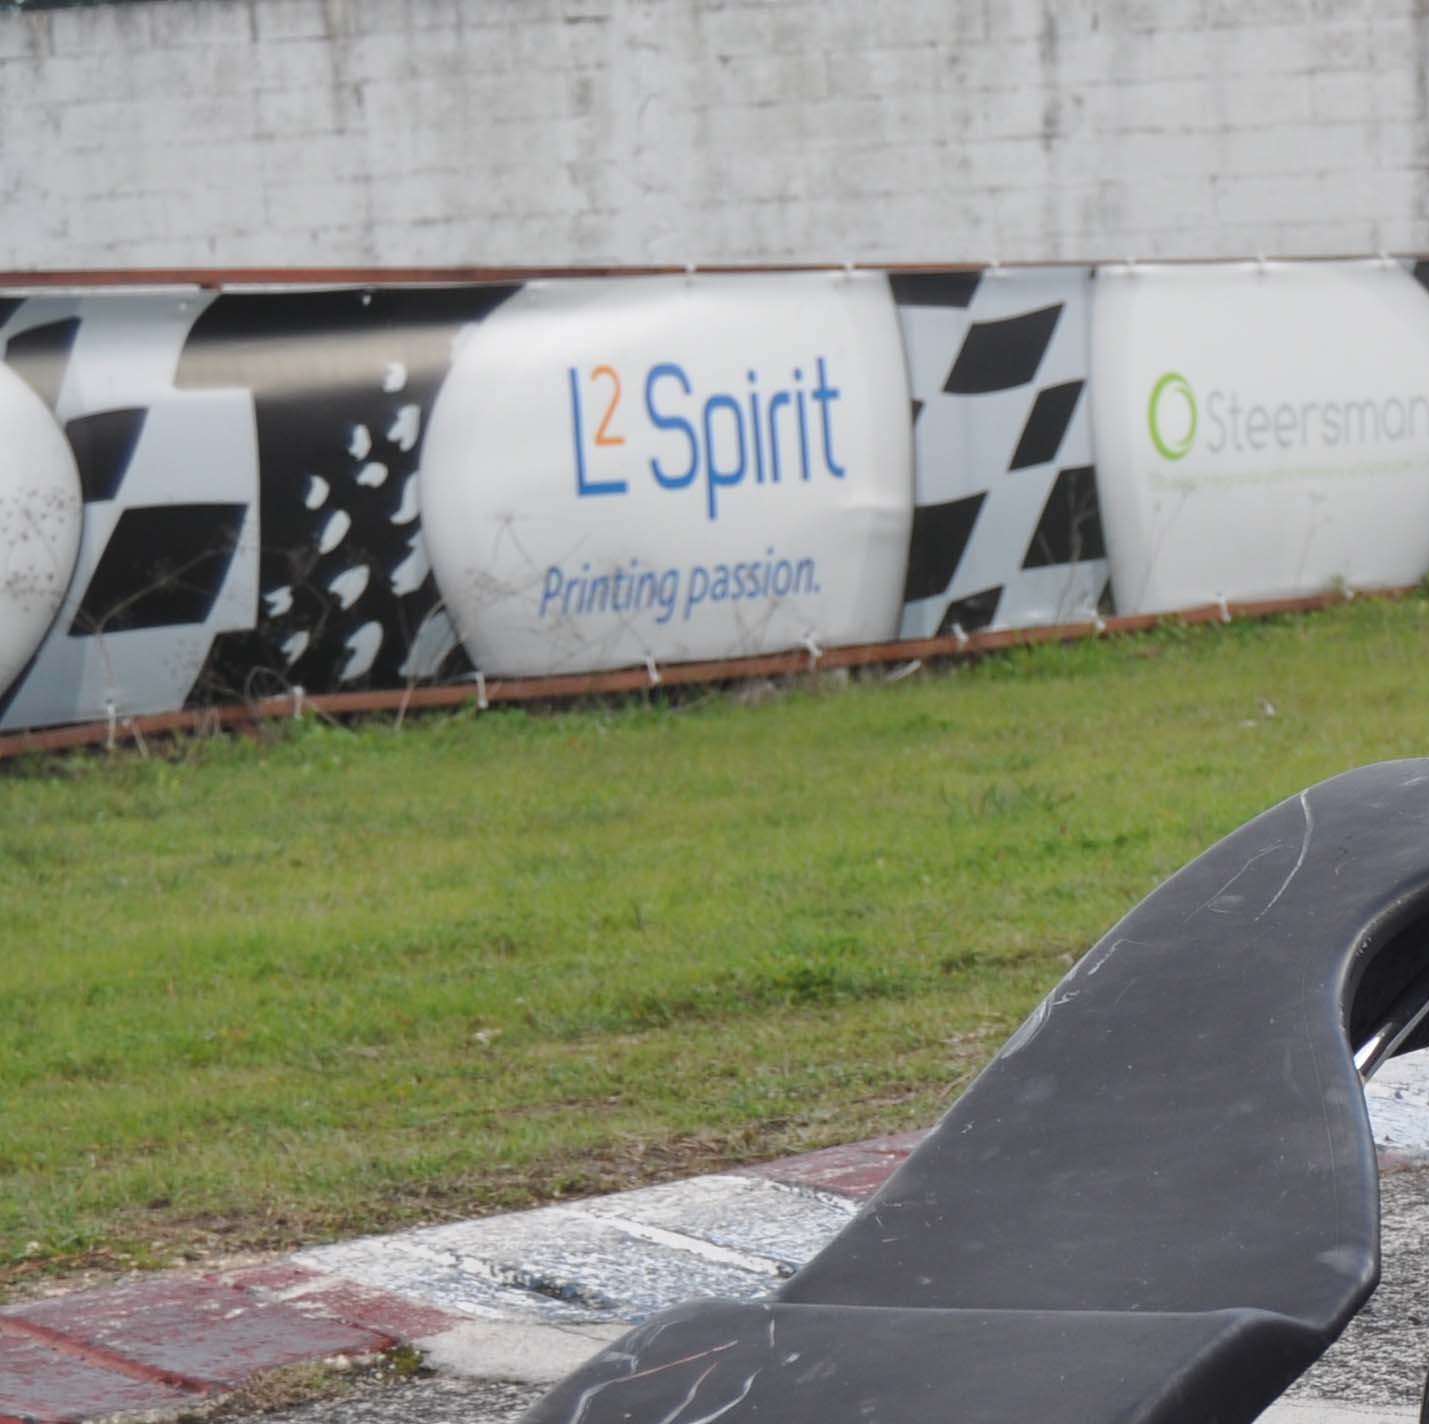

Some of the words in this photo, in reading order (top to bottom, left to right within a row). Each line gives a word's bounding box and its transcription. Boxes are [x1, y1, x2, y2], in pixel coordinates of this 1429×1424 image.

[644, 356, 846, 521] Spirit
[538, 556, 679, 625] Printing
[684, 547, 822, 621] passion.
